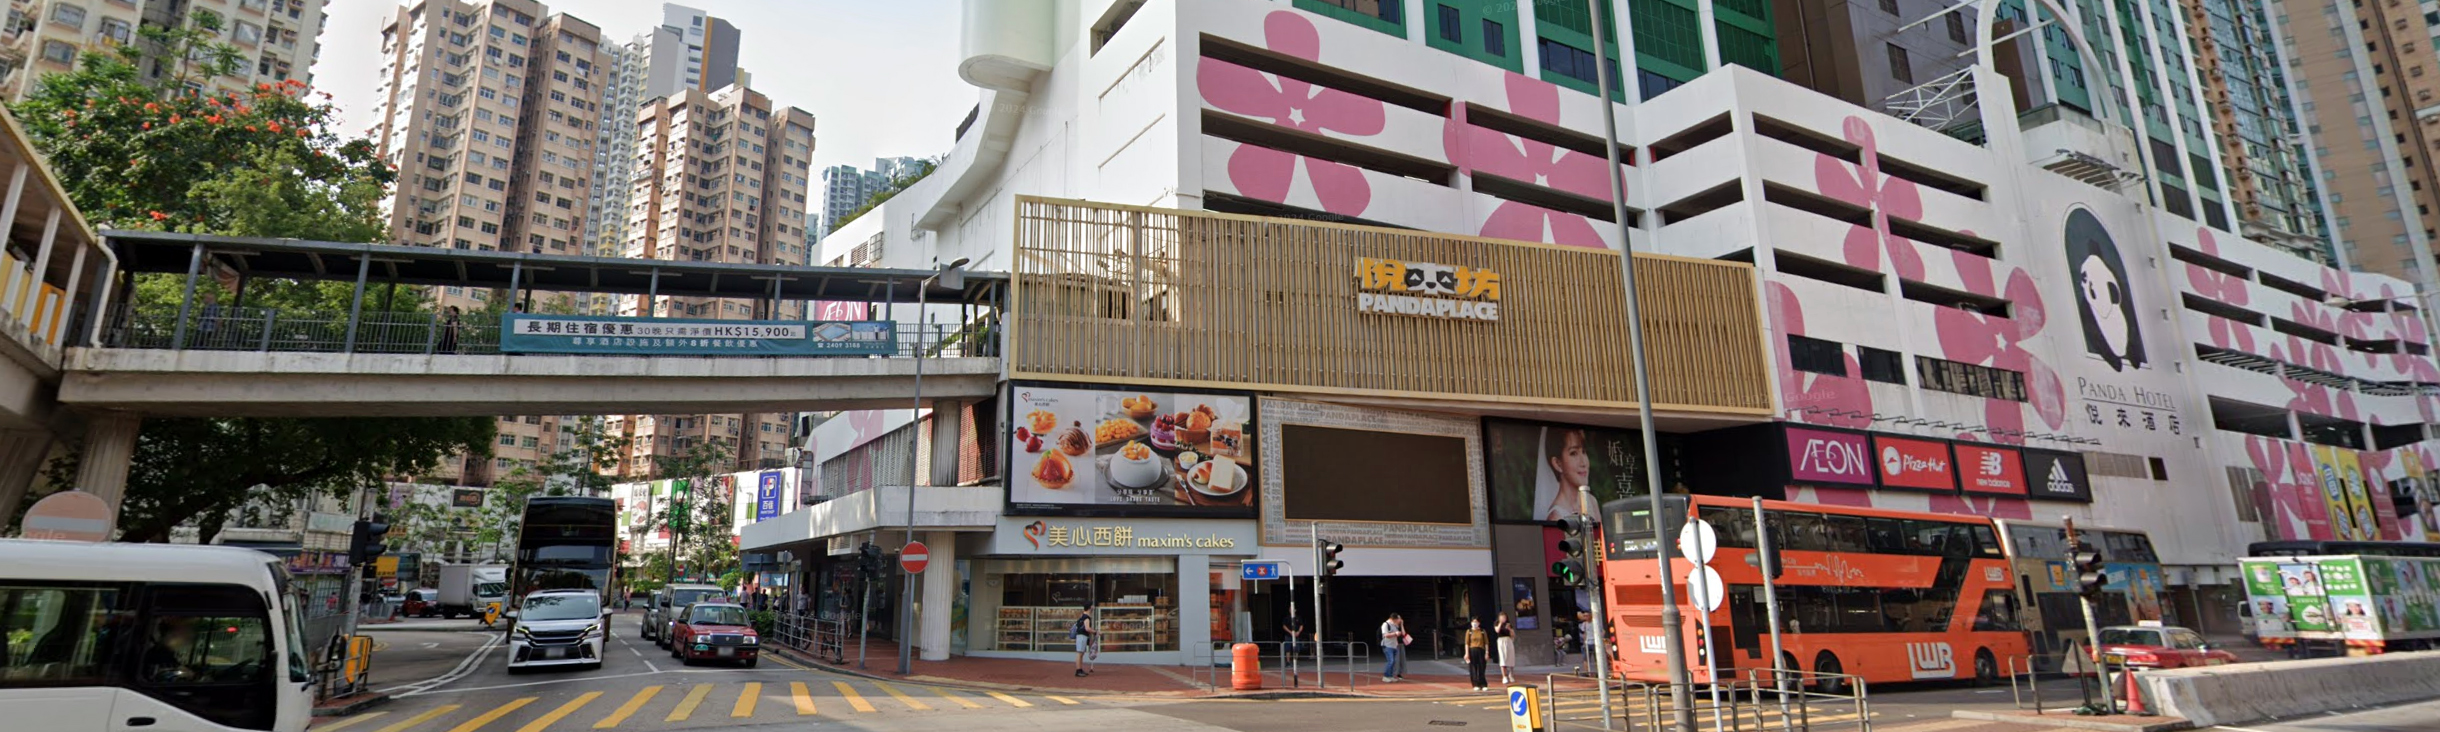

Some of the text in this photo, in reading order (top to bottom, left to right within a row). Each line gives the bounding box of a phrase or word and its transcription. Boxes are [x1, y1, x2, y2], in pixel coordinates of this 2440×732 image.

[1358, 292, 1499, 321] PANDAPLACE
[527, 320, 635, 336] 長期住宿優惠
[714, 326, 789, 338] HK$15,900
[2133, 385, 2177, 410] HOTEL
[1902, 454, 1947, 473] Pizza Hut
[2047, 481, 2075, 493] adidas
[1048, 525, 1133, 547] 美心西餅
[1137, 532, 1234, 548] maxim's cakes
[1906, 642, 1957, 679] LWB
